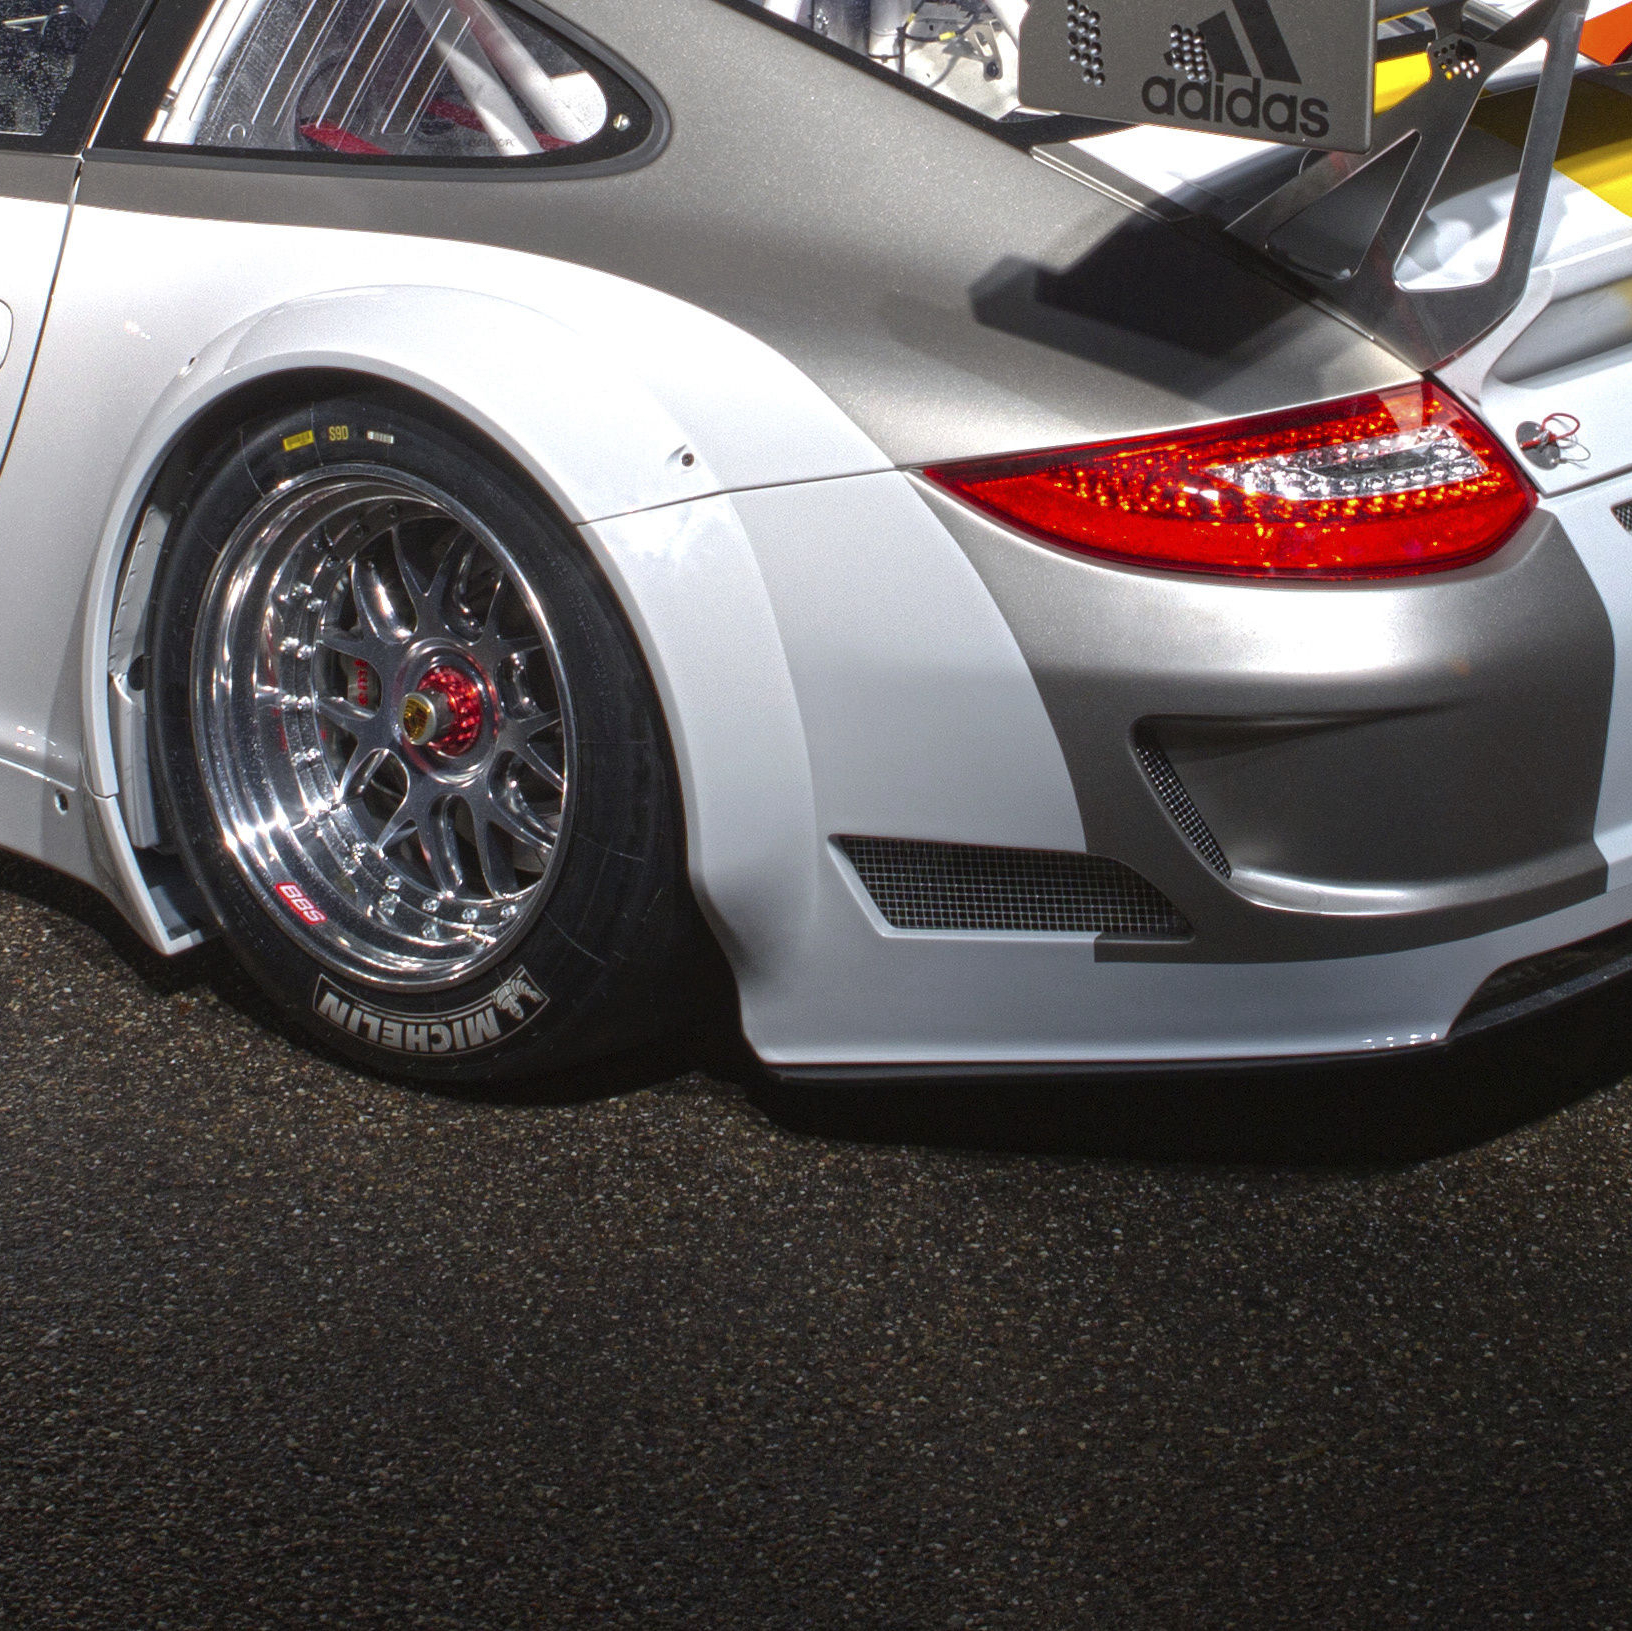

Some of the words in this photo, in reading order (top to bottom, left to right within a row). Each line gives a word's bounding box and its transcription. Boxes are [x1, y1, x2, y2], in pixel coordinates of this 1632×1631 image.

[1141, 72, 1330, 138] adidas
[279, 885, 326, 922] BBS
[318, 991, 501, 1053] MICHELIN
